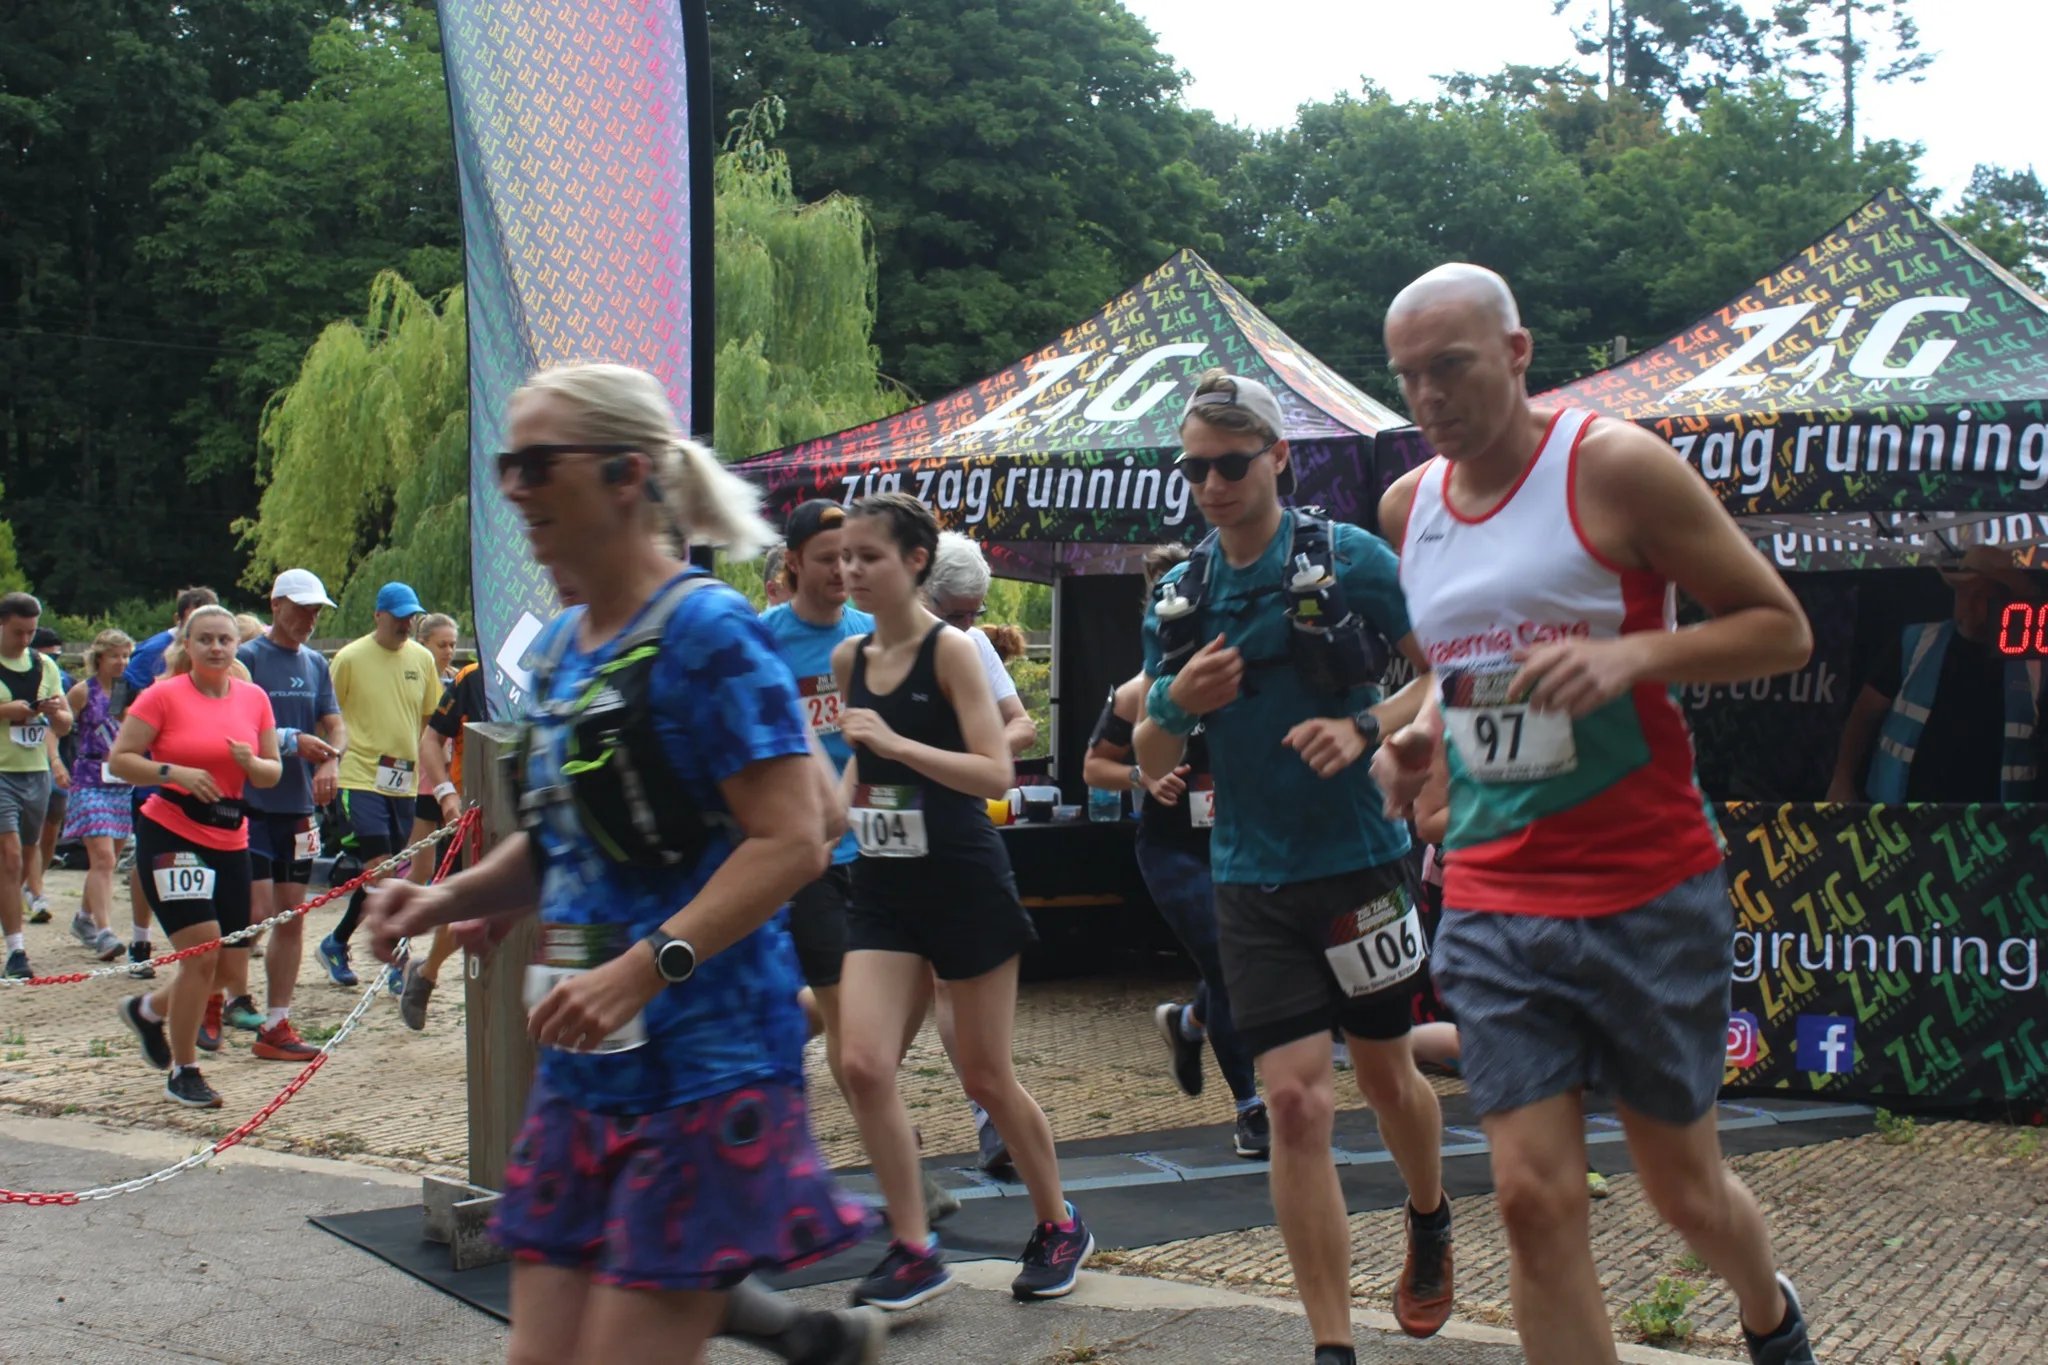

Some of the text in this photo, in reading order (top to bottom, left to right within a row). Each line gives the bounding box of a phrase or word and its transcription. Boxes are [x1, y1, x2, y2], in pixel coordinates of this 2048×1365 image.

[1671, 409, 2048, 494] zag running
[914, 467, 991, 523] zag
[1004, 456, 1187, 525] running
[1474, 712, 1524, 764] 97
[388, 770, 404, 788] 76
[862, 812, 907, 847] 104
[169, 869, 205, 892] 109
[1356, 919, 1418, 980] 106
